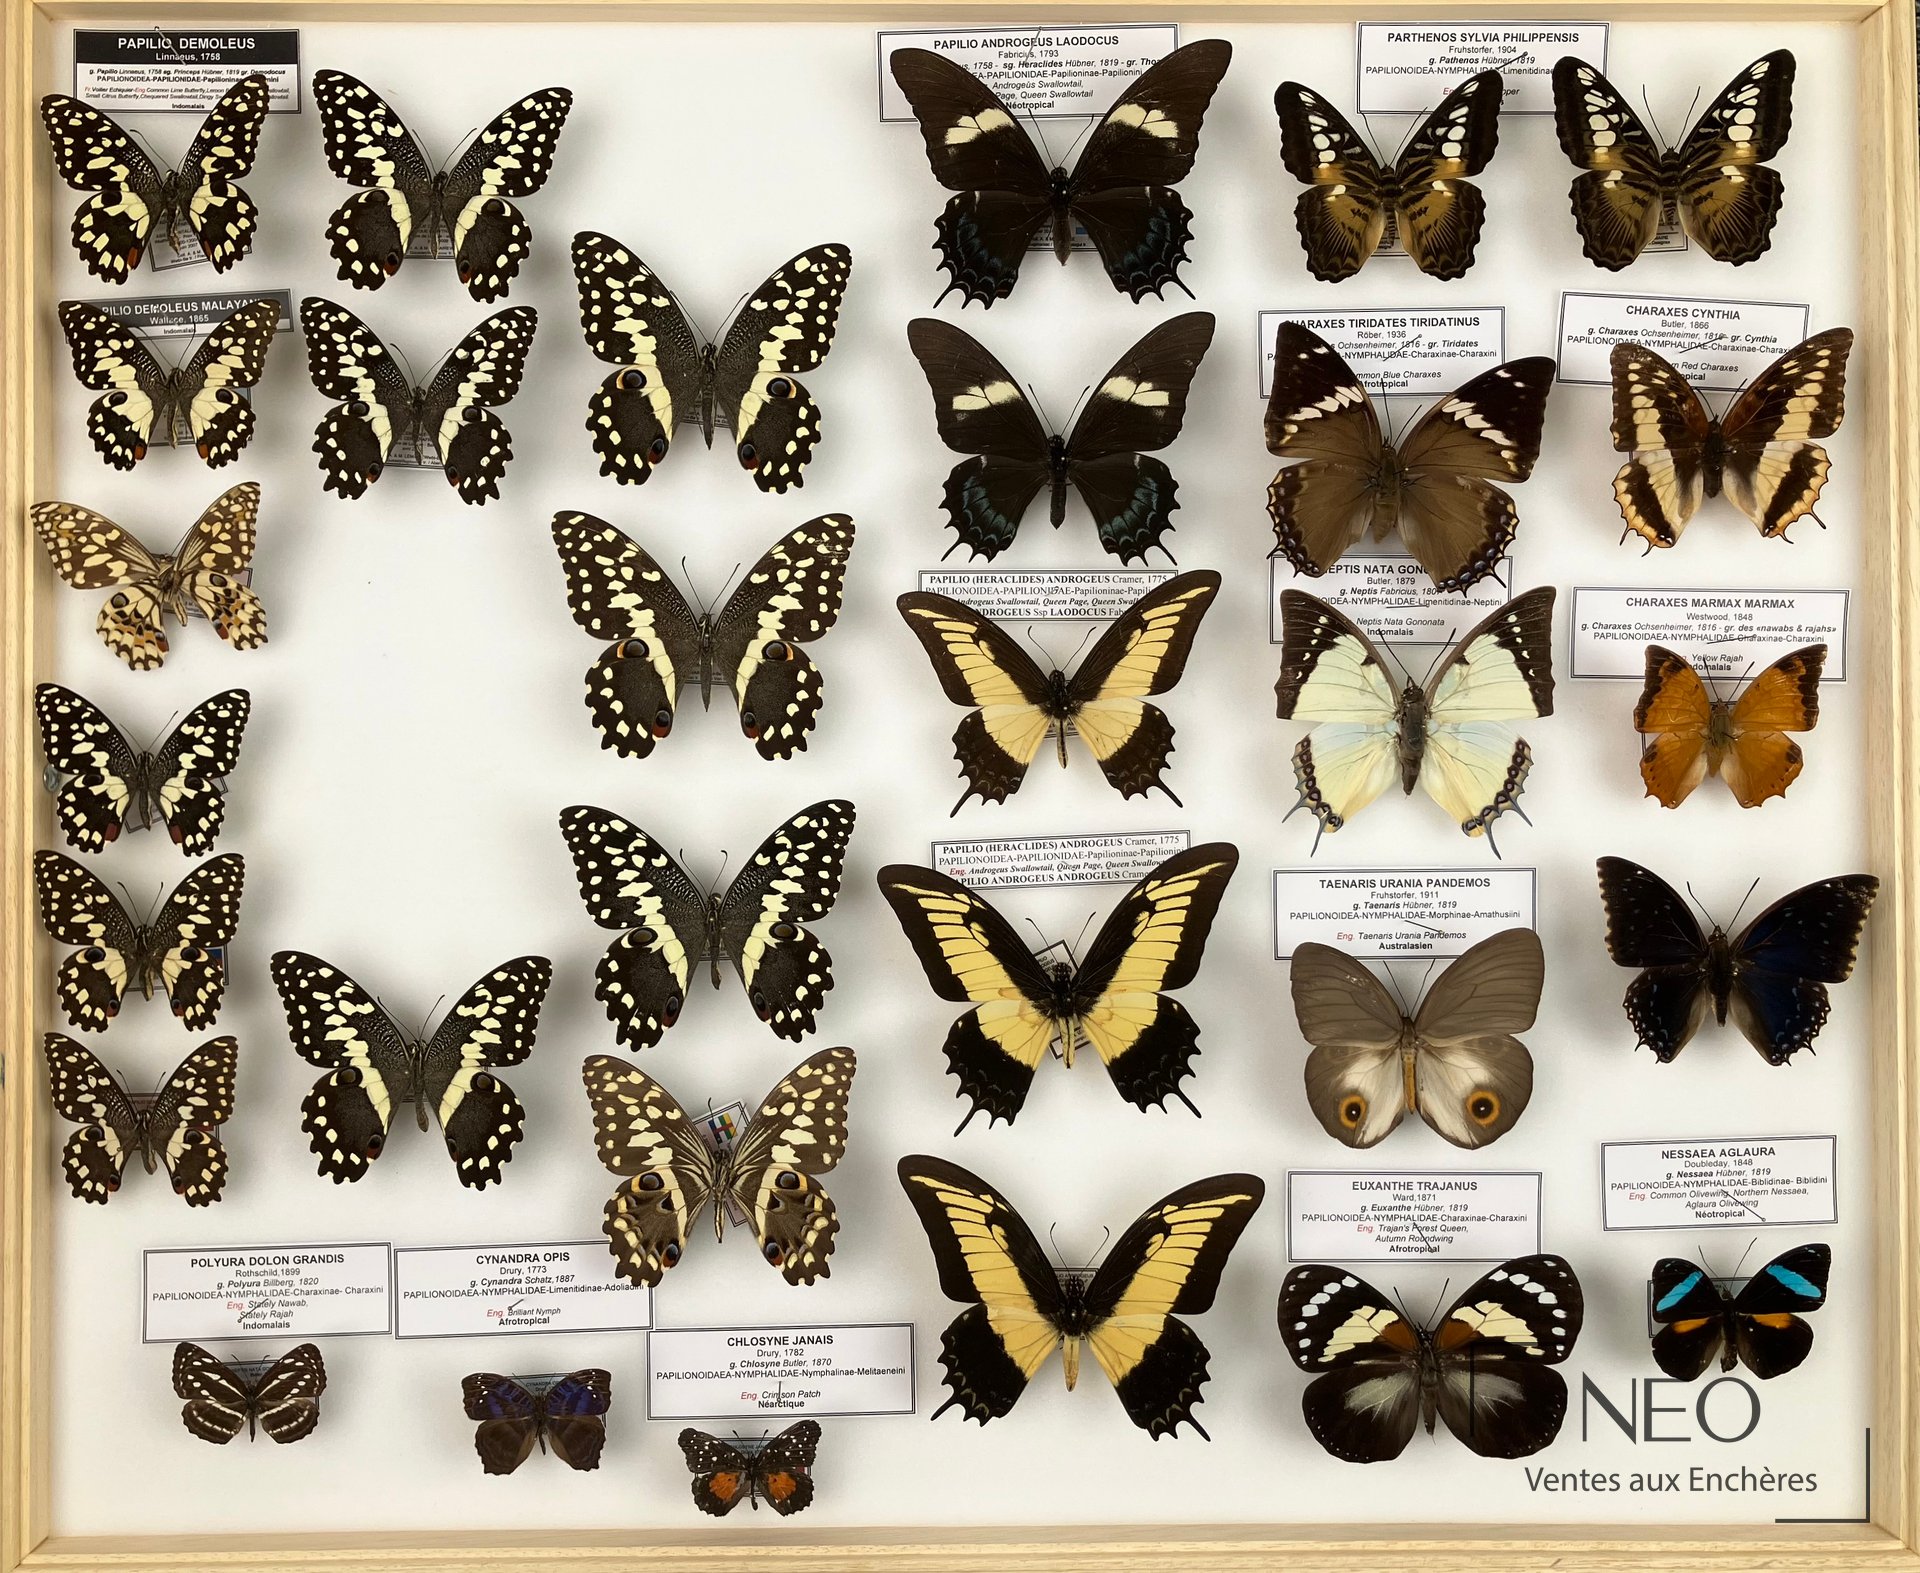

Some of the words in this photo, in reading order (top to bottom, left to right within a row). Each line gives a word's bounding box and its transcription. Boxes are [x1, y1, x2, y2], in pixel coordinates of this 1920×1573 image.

[1388, 33, 1457, 43] PARTHENOS
[1460, 33, 1500, 43] SYLVIA
[1503, 32, 1579, 43] PHILIPPENSIS
[118, 37, 172, 49] PAPILIO
[179, 37, 255, 49] DEMOLEUS
[934, 39, 978, 50] PAPILIO
[981, 37, 1053, 48] ANDROGEUS
[1056, 36, 1119, 47] LAODOCUS
[998, 50, 1036, 59] Fabricius,
[1040, 50, 1059, 58] 1793
[1449, 46, 1494, 54] Fruhstorfer,
[156, 53, 199, 61] Linnaeus,
[1439, 56, 1479, 64] Pathenos
[973, 62, 993, 71] 1758
[1003, 62, 1016, 71] sg.
[1019, 60, 1063, 70] Heraclides
[1065, 59, 1096, 69] Hübner,
[1100, 58, 1118, 67] 1819
[1038, 80, 1083, 89] Swallowtail,
[1020, 91, 1048, 99] Queen
[1050, 90, 1093, 99] Swallowtail
[1626, 305, 1688, 317] CHARAXES
[1692, 309, 1740, 320] CYNTHIA
[189, 314, 209, 322] 1865
[1348, 318, 1407, 328] TIRIDATES
[1410, 317, 1480, 327] TIRIDATINUS
[1661, 320, 1687, 329] Butler,
[1357, 331, 1384, 340] Röber,
[1387, 331, 1406, 339] 1936
[1599, 327, 1638, 336] Charaxes
[1641, 329, 1701, 339] Ochsenheimer,
[1745, 335, 1778, 343] Cynthia
[1338, 340, 1398, 350] Ochsenheimer,
[1442, 340, 1478, 348] Tiridates
[1682, 362, 1698, 370] Red
[1701, 363, 1739, 372] Charaxes
[1403, 370, 1441, 378] Charaxes
[1364, 565, 1395, 574] NATA
[930, 575, 970, 584] PAPILIO
[972, 575, 1045, 585] (HERACLIDES)
[1047, 575, 1110, 583] ANDROGEUS
[1113, 575, 1144, 584] Cramer,
[1367, 577, 1393, 585] Butler,
[1396, 577, 1415, 585] 1879
[1350, 587, 1378, 596] Neptis
[1380, 587, 1420, 596] Fabricius,
[997, 597, 1041, 606] Swallowtail,
[1069, 598, 1089, 607] Page,
[1091, 597, 1116, 606] Queen
[1626, 598, 1688, 608] CHARAXES
[1691, 598, 1741, 608] MARMAX
[1744, 599, 1795, 609] MARMAX
[1034, 608, 1048, 617] Ssp
[1050, 608, 1106, 616] LAODOCUS
[1687, 613, 1731, 621] Westwood,
[1734, 613, 1753, 621] 1848
[1357, 618, 1382, 626] Neptis
[1384, 618, 1403, 626] Nata
[1405, 618, 1445, 626] Gononata
[1592, 621, 1632, 630] Charaxes
[1634, 622, 1695, 632] Ochsenheimer,
[1697, 623, 1717, 631] 1816
[1738, 624, 1754, 632] des
[1367, 628, 1414, 636] Indomalais
[1720, 654, 1743, 663] Rajah
[943, 845, 983, 854] PAPILIO
[986, 842, 1058, 853] (HERACLIDES)
[1059, 839, 1123, 849] ANDROGEUS
[1125, 837, 1158, 846] Cramer,
[1160, 836, 1180, 844] 1775
[968, 865, 1008, 875] Androgeus
[1010, 863, 1054, 872] Swallowtail,
[1083, 861, 1103, 870] Page,
[1105, 860, 1129, 869] Queen
[991, 874, 1055, 884] ANDROGEUS
[1057, 871, 1120, 881] ANDROGEUS
[1319, 879, 1377, 889] TAENARIS
[1380, 879, 1423, 888] URANIA
[1426, 878, 1491, 888] PANDEMOS
[1371, 891, 1418, 900] Fruhstorfer,
[1364, 901, 1401, 909] Taenaris
[1403, 901, 1435, 910] Hübner,
[1437, 901, 1457, 909] 1819
[1359, 932, 1393, 940] Taenaris
[1395, 932, 1421, 940] Urania
[1379, 941, 1433, 950] Australasien
[1662, 1149, 1717, 1159] NESSAEA
[1719, 1147, 1776, 1157] AGLAURA
[1684, 1160, 1730, 1168] Doubleday,
[1733, 1158, 1753, 1166] 1848
[1677, 1169, 1713, 1179] Nessaea
[1716, 1168, 1748, 1177] Hübner,
[1751, 1168, 1771, 1176] 1819
[1796, 1176, 1828, 1185] Biblidini
[1352, 1181, 1413, 1191] EUXANTHE
[1417, 1181, 1478, 1191] TRAJANUS
[1393, 1193, 1436, 1203] Ward,1871
[1650, 1191, 1687, 1199] Common
[1733, 1188, 1769, 1197] Northern
[1771, 1187, 1809, 1196] Nessaea,
[1371, 1204, 1411, 1212] Euxanthe
[1414, 1204, 1446, 1212] Hübner,
[1448, 1204, 1468, 1212] 1819
[1685, 1200, 1716, 1209] Aglaura
[1695, 1209, 1745, 1219] Néotropical
[1378, 1224, 1410, 1233] Trajan's
[1440, 1224, 1469, 1233] Queen,
[1375, 1234, 1406, 1242] Autumn
[1408, 1234, 1453, 1244] Roundwing
[191, 1257, 246, 1268] POLYURA
[249, 1255, 290, 1266] DOLON
[293, 1254, 345, 1264] GRANDIS
[476, 1254, 540, 1265] CYNANDRA
[543, 1252, 570, 1262] OPIS
[236, 1267, 300, 1278] Rothschild,1899
[500, 1266, 525, 1275] Drury,
[527, 1265, 547, 1274] 1773
[227, 1279, 261, 1289] Polyura
[263, 1278, 295, 1288] Billberg,
[299, 1277, 319, 1286] 1820
[481, 1277, 523, 1287] Cynandra
[345, 1285, 383, 1294] Charaxini
[278, 1299, 308, 1308] Nawab,
[270, 1309, 293, 1319] Rajah
[536, 1307, 561, 1316] Nymph
[243, 1321, 290, 1329] Indomalais
[499, 1316, 550, 1326] Afrotropical
[727, 1336, 789, 1347] CHLOSYNE
[792, 1335, 834, 1345] JANAIS
[757, 1349, 782, 1358] Drury,
[784, 1348, 804, 1357] 1782
[740, 1359, 781, 1368] Chlosyne
[783, 1358, 808, 1368] Butler,
[812, 1358, 832, 1366] 1870
[798, 1390, 821, 1398] Patch
